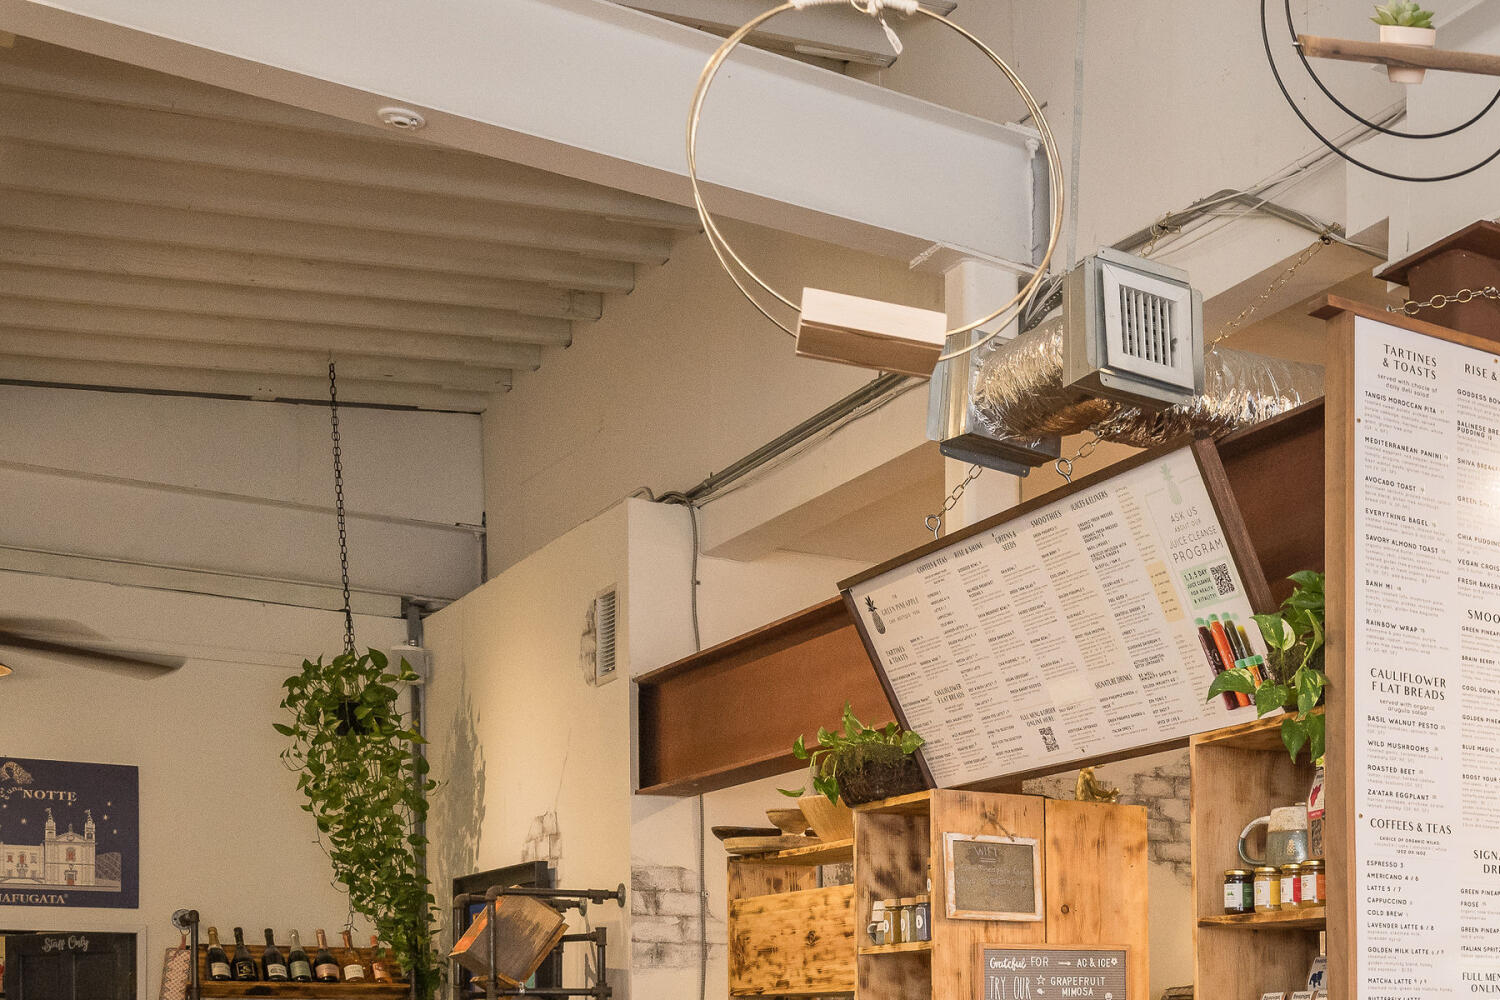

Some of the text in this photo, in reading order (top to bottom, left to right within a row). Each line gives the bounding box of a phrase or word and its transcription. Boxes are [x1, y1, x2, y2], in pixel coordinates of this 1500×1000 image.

[1384, 344, 1437, 367] TARTINES
[1383, 358, 1436, 380] & TOASTS
[1465, 364, 1488, 378] RISE
[1492, 370, 1498, 380] &
[1365, 436, 1418, 454] MEDITERRANEAN
[1421, 449, 1442, 460] PANINI
[1365, 476, 1416, 492] AVOCADO TOAST
[1030, 510, 1062, 528] SMOOTHIES
[1170, 506, 1198, 524] ASK US
[1366, 508, 1428, 526] EVERYTHING BAGEL
[1169, 525, 1218, 550] JUICE CLEANSE
[1366, 534, 1438, 554] SAVORY ALMOND TOAST
[1172, 538, 1224, 564] PROGRAM
[1458, 558, 1478, 568] VEGAN
[1458, 578, 1477, 586] FRESH
[1480, 581, 1500, 590] BAKERY
[1366, 618, 1418, 632] RAINBOW WRAP
[1370, 668, 1446, 688] CAULIFLOWER
[1404, 686, 1445, 700] BREADS
[1368, 714, 1438, 730] BASIL WALNUT PESTO
[1388, 742, 1430, 752] MUSHROOMS
[1368, 764, 1398, 774] ROASTED
[22, 790, 77, 802] NOTTE
[1370, 818, 1452, 834] COFFEES & TEAS
[42, 935, 90, 952] Staff Only
[990, 957, 1110, 971] Grateful FOR AC & ICE
[1462, 972, 1483, 981] FULL
[990, 976, 1106, 1000] TRY OUR GRAPEFRUIT
[1062, 987, 1094, 996] MIMOSA
